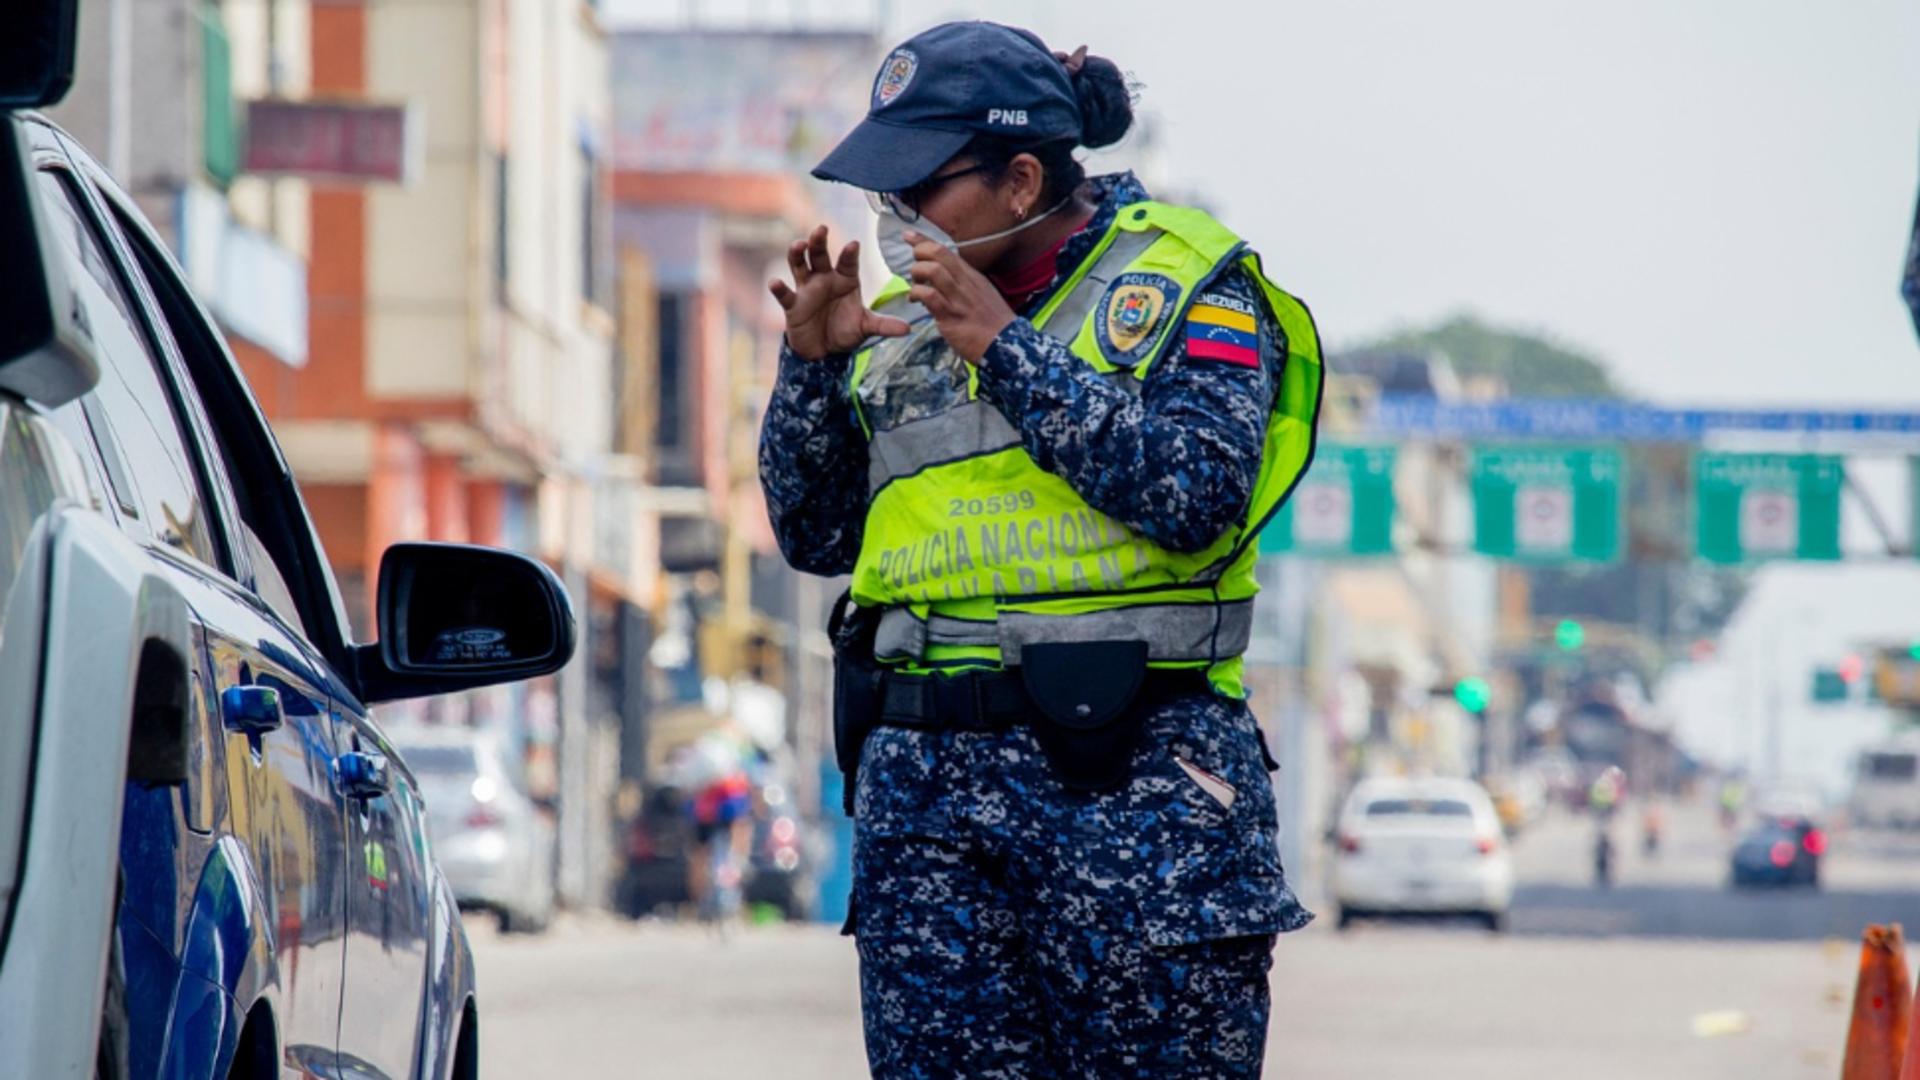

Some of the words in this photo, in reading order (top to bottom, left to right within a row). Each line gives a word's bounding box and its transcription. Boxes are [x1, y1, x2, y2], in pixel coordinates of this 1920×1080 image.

[987, 108, 1029, 126] PNB
[1194, 293, 1256, 316] ENEZUELA
[948, 489, 1036, 517] 20599
[879, 525, 975, 589] POLICIA
[981, 507, 1128, 569] NACIONA
